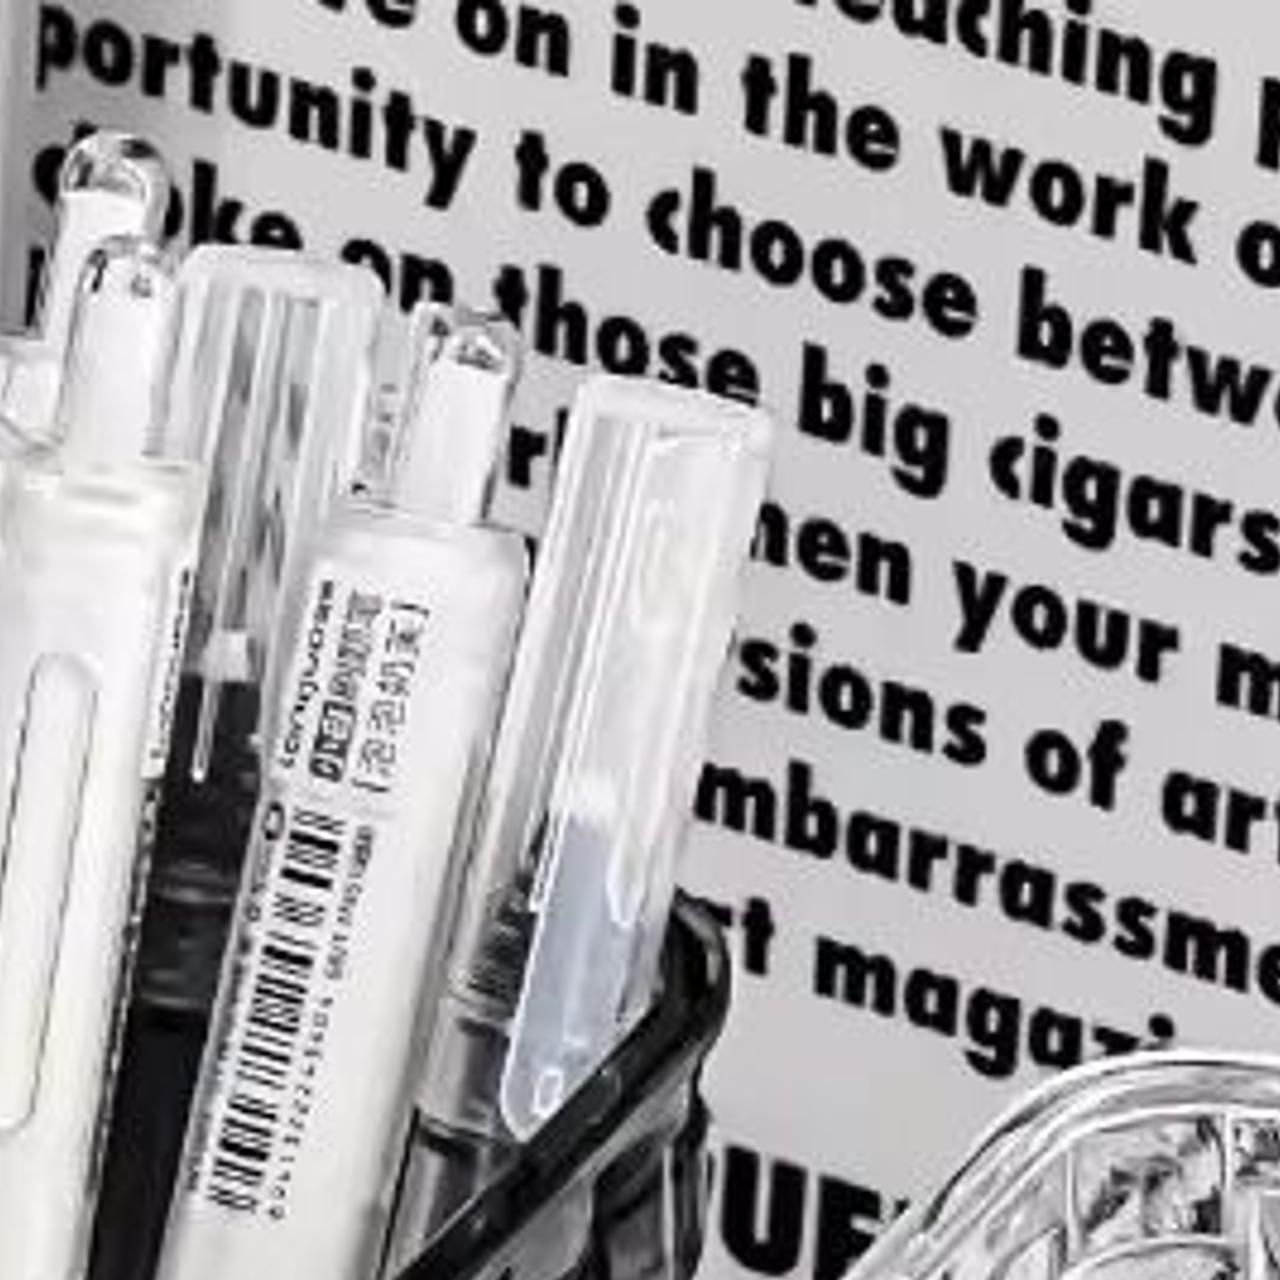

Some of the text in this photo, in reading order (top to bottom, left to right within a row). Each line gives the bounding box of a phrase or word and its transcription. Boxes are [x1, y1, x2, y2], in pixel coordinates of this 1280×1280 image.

[34, 4, 477, 209] portunity
[515, 131, 610, 227] to
[646, 167, 977, 338] choose
[456, 0, 569, 77] on
[612, 3, 698, 115] in
[741, 53, 899, 171] the
[941, 127, 1198, 265] work
[487, 264, 759, 407] those
[798, 342, 949, 499] big
[737, 623, 986, 766] sions
[1025, 720, 1128, 811] of
[953, 561, 1179, 683] your
